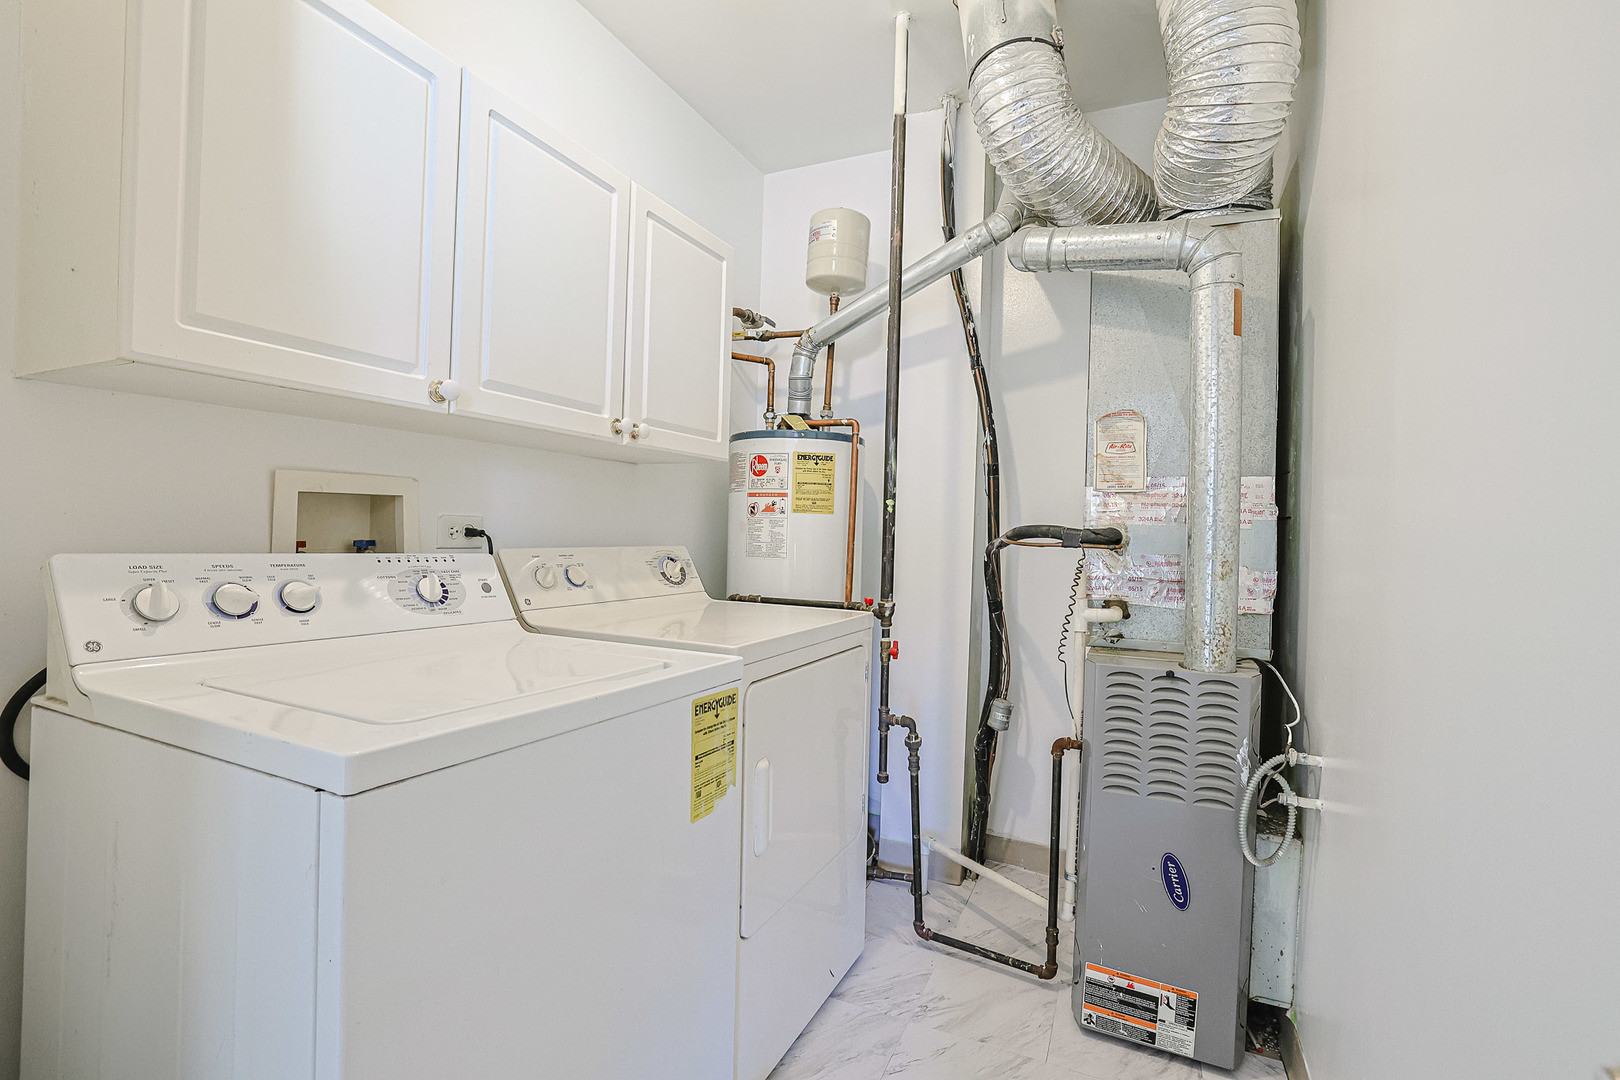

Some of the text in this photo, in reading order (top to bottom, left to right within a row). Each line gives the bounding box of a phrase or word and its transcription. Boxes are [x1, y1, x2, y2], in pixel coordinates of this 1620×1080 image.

[751, 456, 768, 474] Rheem
[695, 694, 736, 716] ENERGYGUIDE
[1167, 861, 1184, 902] Carrier
